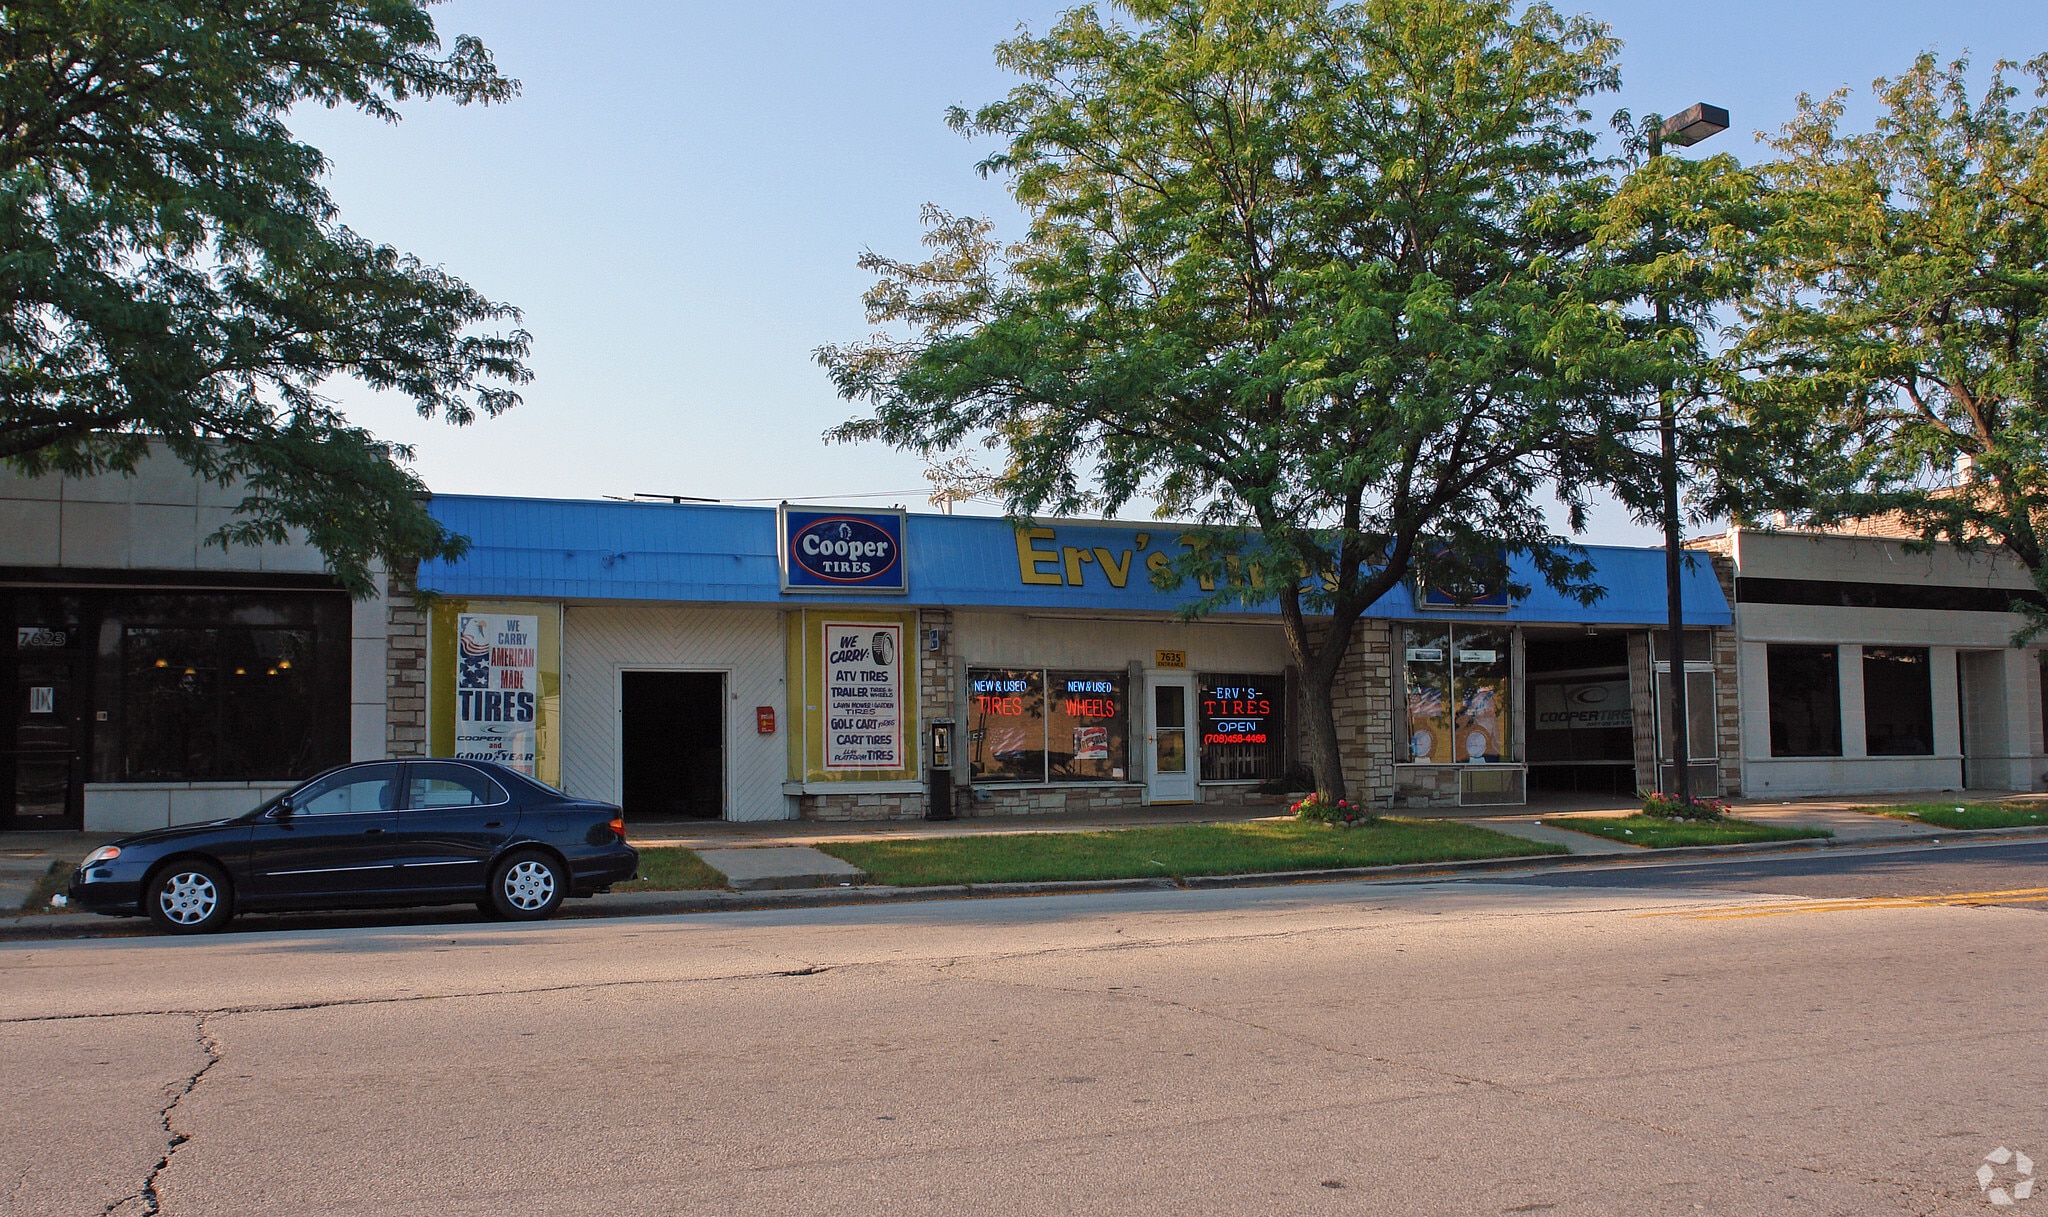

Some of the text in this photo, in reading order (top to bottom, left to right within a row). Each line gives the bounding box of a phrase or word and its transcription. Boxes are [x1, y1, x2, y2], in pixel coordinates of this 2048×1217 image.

[803, 534, 888, 561] Cooper
[1014, 527, 1175, 588] Erv's
[823, 561, 871, 573] TIRES
[507, 620, 520, 632] WE
[20, 631, 66, 646] 7623
[498, 633, 527, 645] CARRY
[840, 635, 859, 648] WE
[491, 647, 534, 667] AMERICAN
[830, 649, 870, 664] CARRY:
[1161, 653, 1181, 662] 7635
[500, 670, 524, 689] MADE
[836, 670, 889, 682] ATV TIRES
[831, 687, 869, 698] TRAILER
[974, 680, 1027, 693] NEW & USED
[1067, 681, 1112, 693] NEW & USED
[459, 691, 534, 722] TIRES
[977, 696, 1023, 716] TIRES
[1065, 699, 1115, 718] WHEELS
[1203, 700, 1271, 715] TIRES
[1540, 709, 1632, 722] COOPERTIRE
[831, 719, 854, 730] GOLF
[856, 719, 878, 730] CART
[1217, 721, 1256, 733] OPEN
[837, 735, 892, 745] CART TIRES
[867, 750, 894, 761] TIRES
